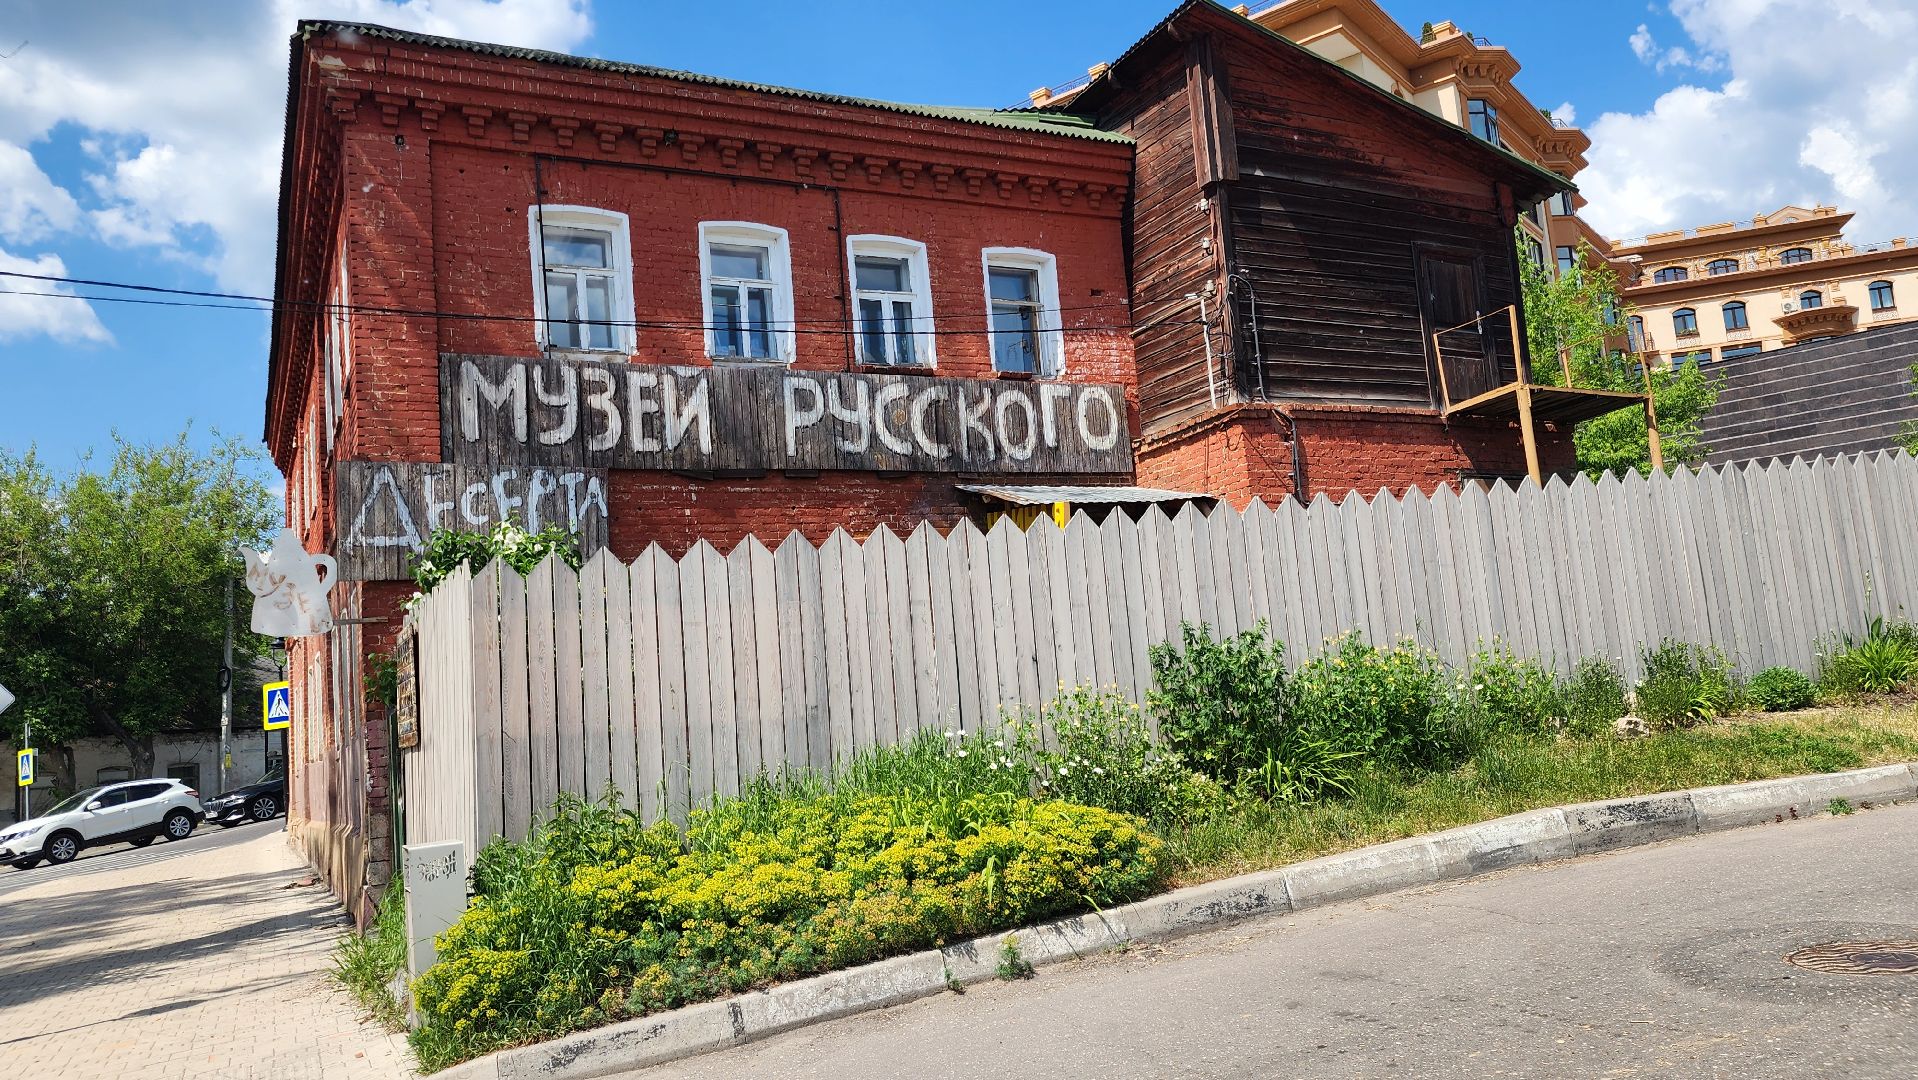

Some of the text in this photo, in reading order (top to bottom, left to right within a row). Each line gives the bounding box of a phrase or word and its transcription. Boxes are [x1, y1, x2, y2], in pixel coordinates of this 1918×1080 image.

[459, 360, 1118, 461] МУЗЕЙ РУССКОГО
[343, 465, 608, 556] ДЕСЕРТА
